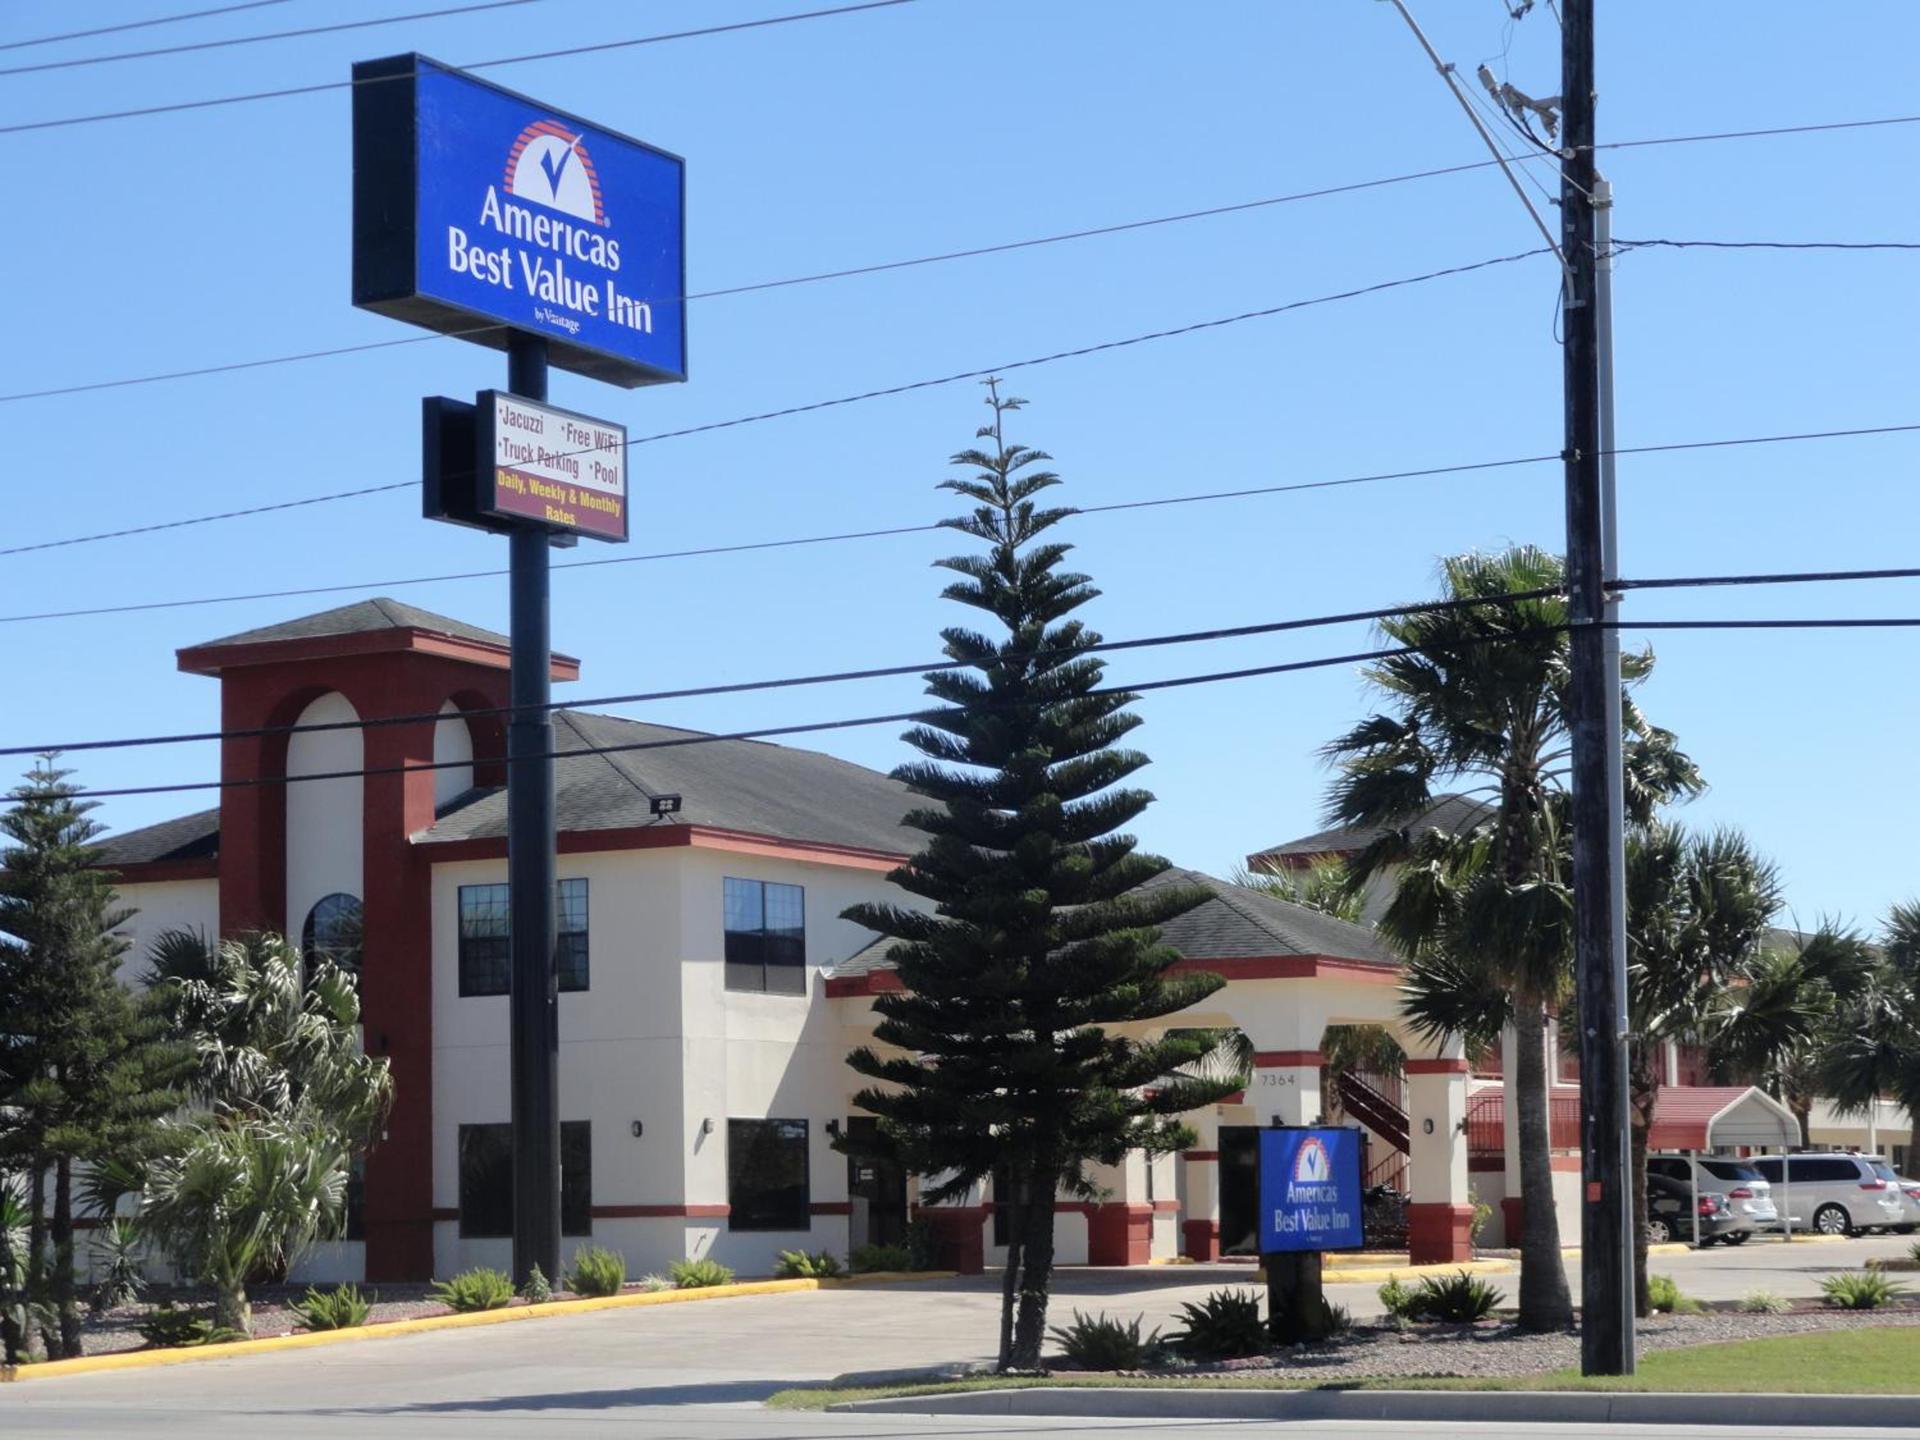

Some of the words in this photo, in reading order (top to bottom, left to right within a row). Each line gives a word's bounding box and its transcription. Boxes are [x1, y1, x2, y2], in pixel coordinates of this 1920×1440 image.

[480, 184, 620, 272] Americas
[449, 225, 513, 289] Best
[519, 250, 599, 316] Value
[607, 280, 651, 333] Inn
[534, 307, 544, 323] by
[544, 309, 580, 335] Vantage
[503, 406, 543, 434] Jacuzzi
[567, 423, 590, 447] Free
[594, 430, 618, 455] WiFi
[503, 437, 533, 462] Truck
[537, 446, 579, 479] Parking
[594, 461, 618, 485] Pool
[498, 470, 526, 495] Daily,
[529, 478, 566, 504] Weekly
[569, 489, 577, 504] &
[580, 491, 620, 517] Monthly
[545, 505, 576, 526] Rates
[1262, 1075, 1295, 1087] 7364
[1286, 1181, 1338, 1203] Americas
[1274, 1209, 1299, 1232] Best
[1301, 1207, 1330, 1232] Value
[1333, 1208, 1350, 1229] Inn
